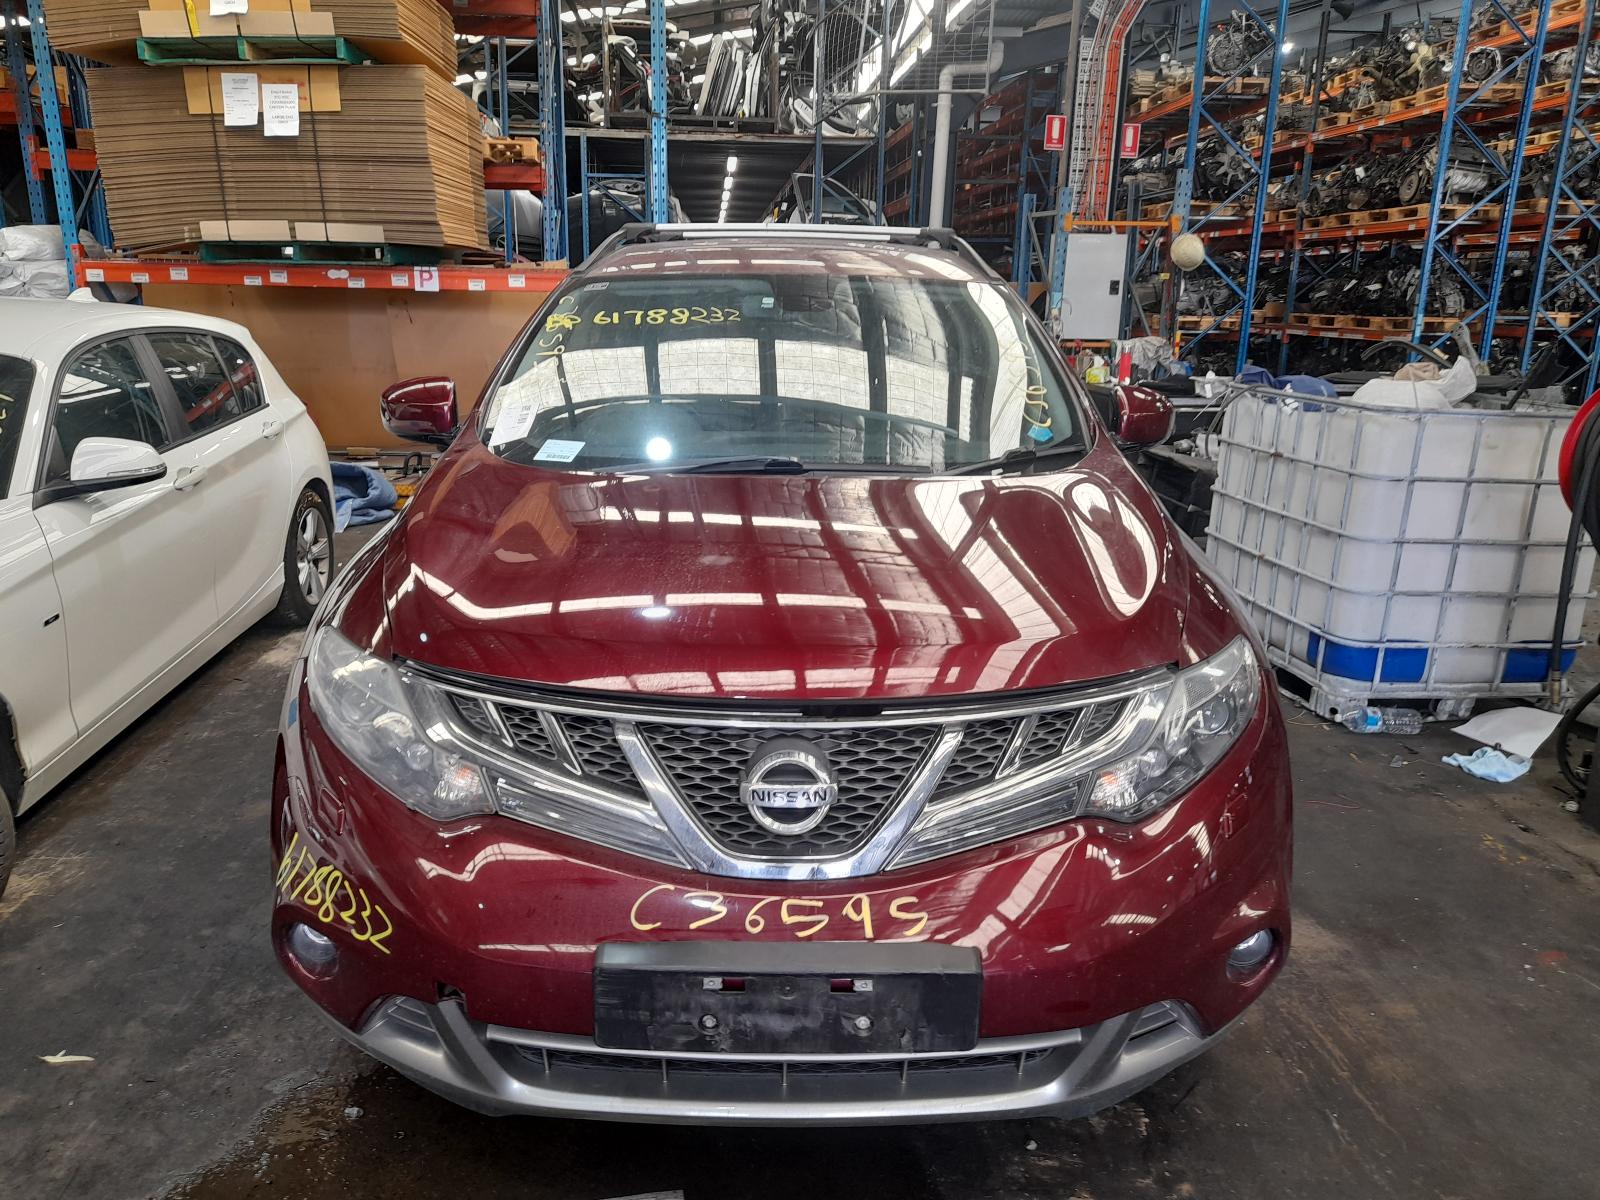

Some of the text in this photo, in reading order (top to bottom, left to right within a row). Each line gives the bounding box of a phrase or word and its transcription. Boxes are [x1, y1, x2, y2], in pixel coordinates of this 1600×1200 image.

[418, 270, 434, 288] P
[593, 306, 741, 326] 61788232
[751, 789, 828, 803] NISSAN
[276, 833, 393, 954] 61788232
